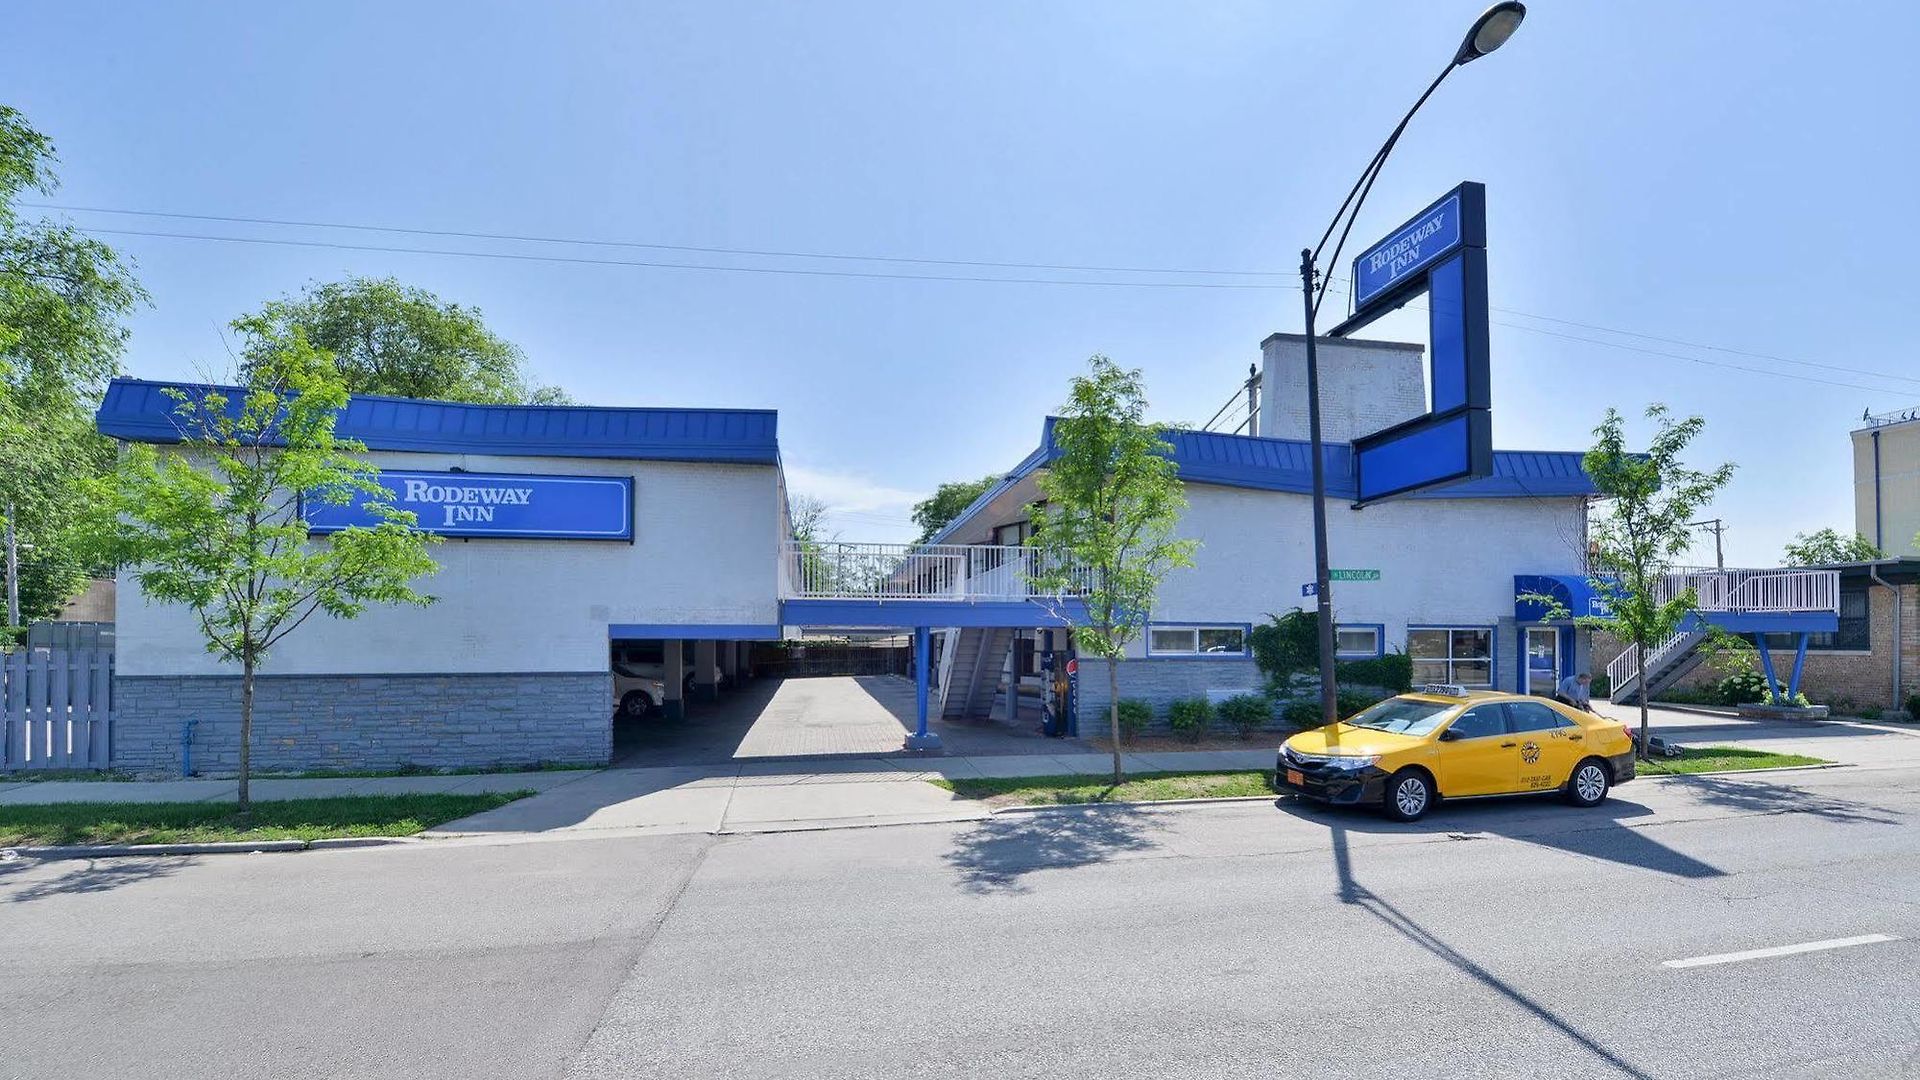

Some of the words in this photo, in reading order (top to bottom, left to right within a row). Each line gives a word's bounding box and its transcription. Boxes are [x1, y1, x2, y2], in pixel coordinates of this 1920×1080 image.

[1369, 213, 1444, 274] RODEWAY
[1389, 245, 1420, 280] INN
[404, 479, 533, 505] RODEWAY
[443, 504, 495, 526] INN
[1339, 570, 1372, 580] LINCOLN
